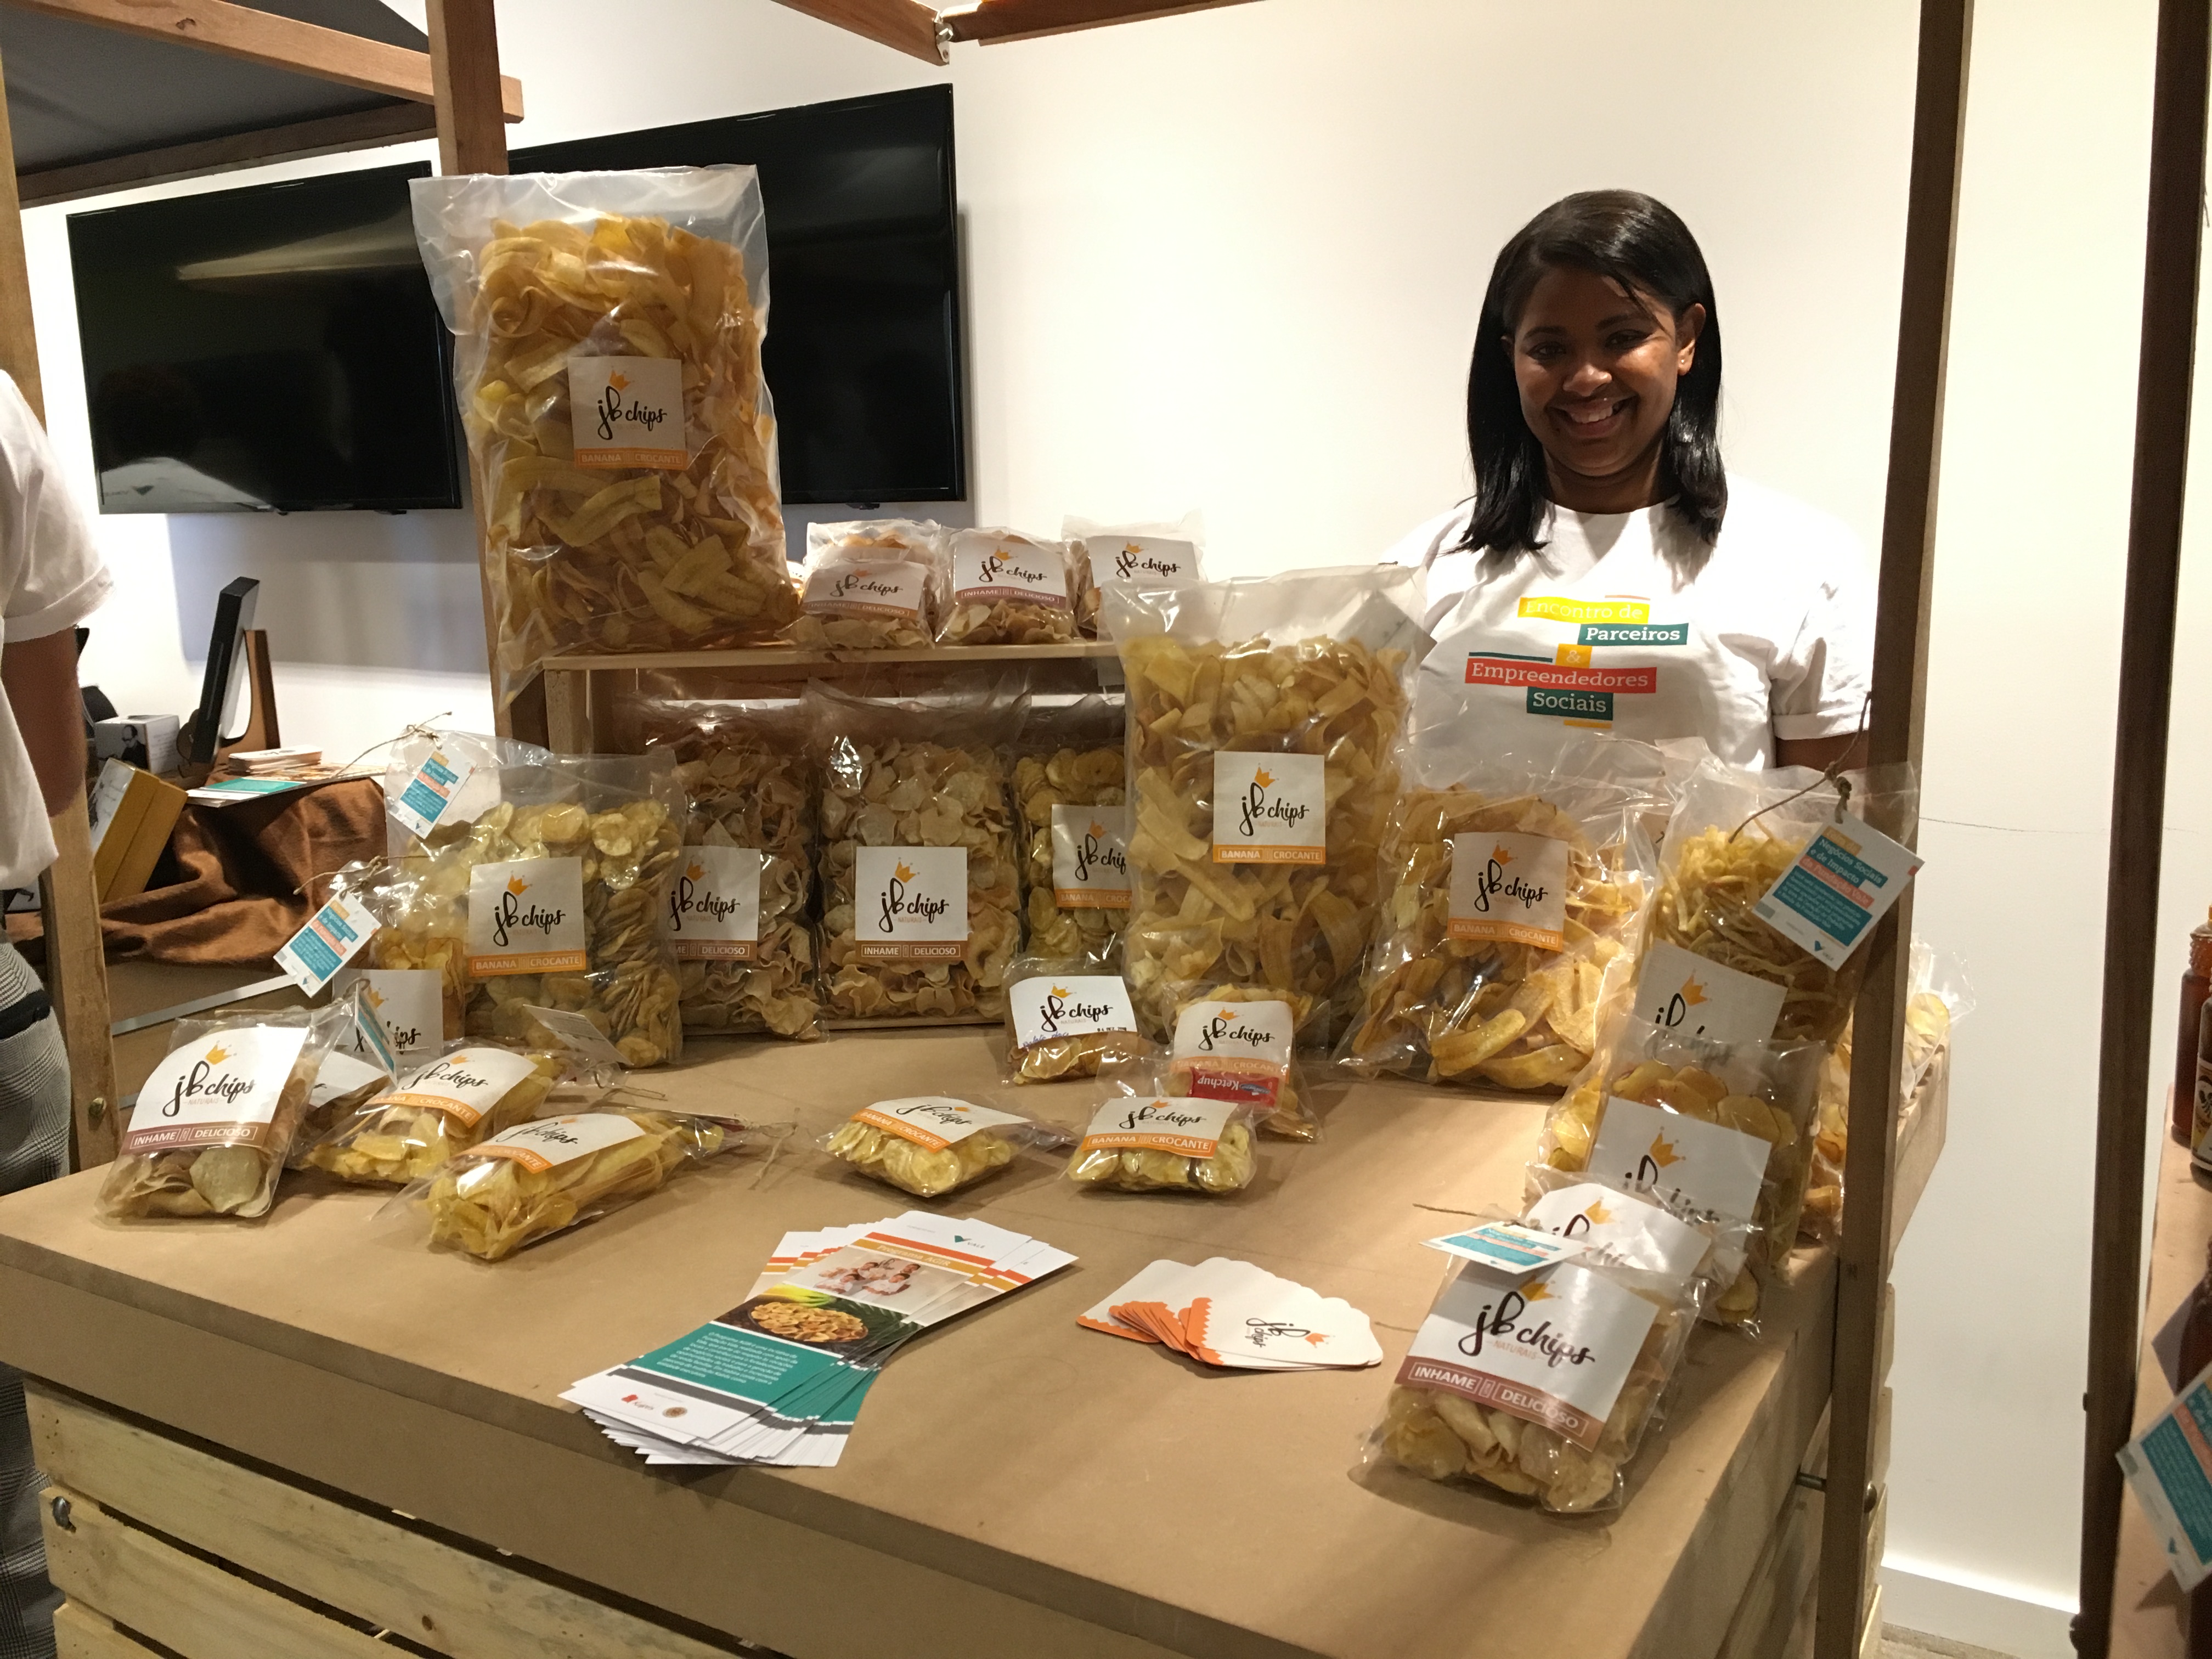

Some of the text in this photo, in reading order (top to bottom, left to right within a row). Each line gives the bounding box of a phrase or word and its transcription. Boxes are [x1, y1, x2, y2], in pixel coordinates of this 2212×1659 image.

[597, 386, 667, 440] jb chips
[582, 454, 681, 464] BANANA CROCANTE
[979, 556, 1047, 583] jb chips
[1115, 550, 1181, 578] jb chips
[830, 574, 903, 597] jb chips
[1014, 591, 1055, 601] DELICIOSO
[862, 605, 905, 614] DELICIOSO
[1526, 601, 1643, 619] Encontro de
[1585, 627, 1680, 641] Parceiros
[1566, 650, 1581, 663] &
[1471, 663, 1648, 686] Empreendedores
[1532, 692, 1607, 713] Sociais
[1239, 782, 1310, 836] jb chips
[1075, 833, 1126, 881] jb chip
[1273, 851, 1320, 860] CROCANTE
[1816, 852, 1827, 862] de
[1827, 859, 1859, 884] Impacto
[1854, 861, 1882, 884] Sociais
[1474, 859, 1548, 912] jb chips
[668, 876, 741, 931] jb chips
[879, 878, 950, 933] jb chips
[493, 891, 566, 946] jb chips
[1454, 924, 1556, 944] BANANA CROCANTE
[702, 946, 745, 955] DELICIOSO
[864, 947, 899, 955] INHAME
[476, 956, 579, 970] BANANA CROCANTE
[1040, 995, 1113, 1032] jb chips
[1198, 1018, 1275, 1051] jb chips
[402, 1063, 488, 1090] jb chips
[1198, 1075, 1239, 1090] Ketchup
[162, 1061, 256, 1117] jb chips
[420, 1098, 472, 1119] CROCANTE
[1119, 1106, 1206, 1129] jb chips
[135, 1131, 176, 1146] INHAME
[195, 1126, 251, 1138] DELICIOSO
[860, 1111, 941, 1147] BANANA CROCANTE
[1092, 1136, 1209, 1150] BANANA CROCANTE
[877, 1245, 951, 1267] Programa AGIR
[1458, 1291, 1595, 1368] jb chips
[1494, 1340, 1537, 1360] NATURAIS
[1414, 1366, 1477, 1390] INHAME
[1501, 1389, 1578, 1429] DELICIOSO
